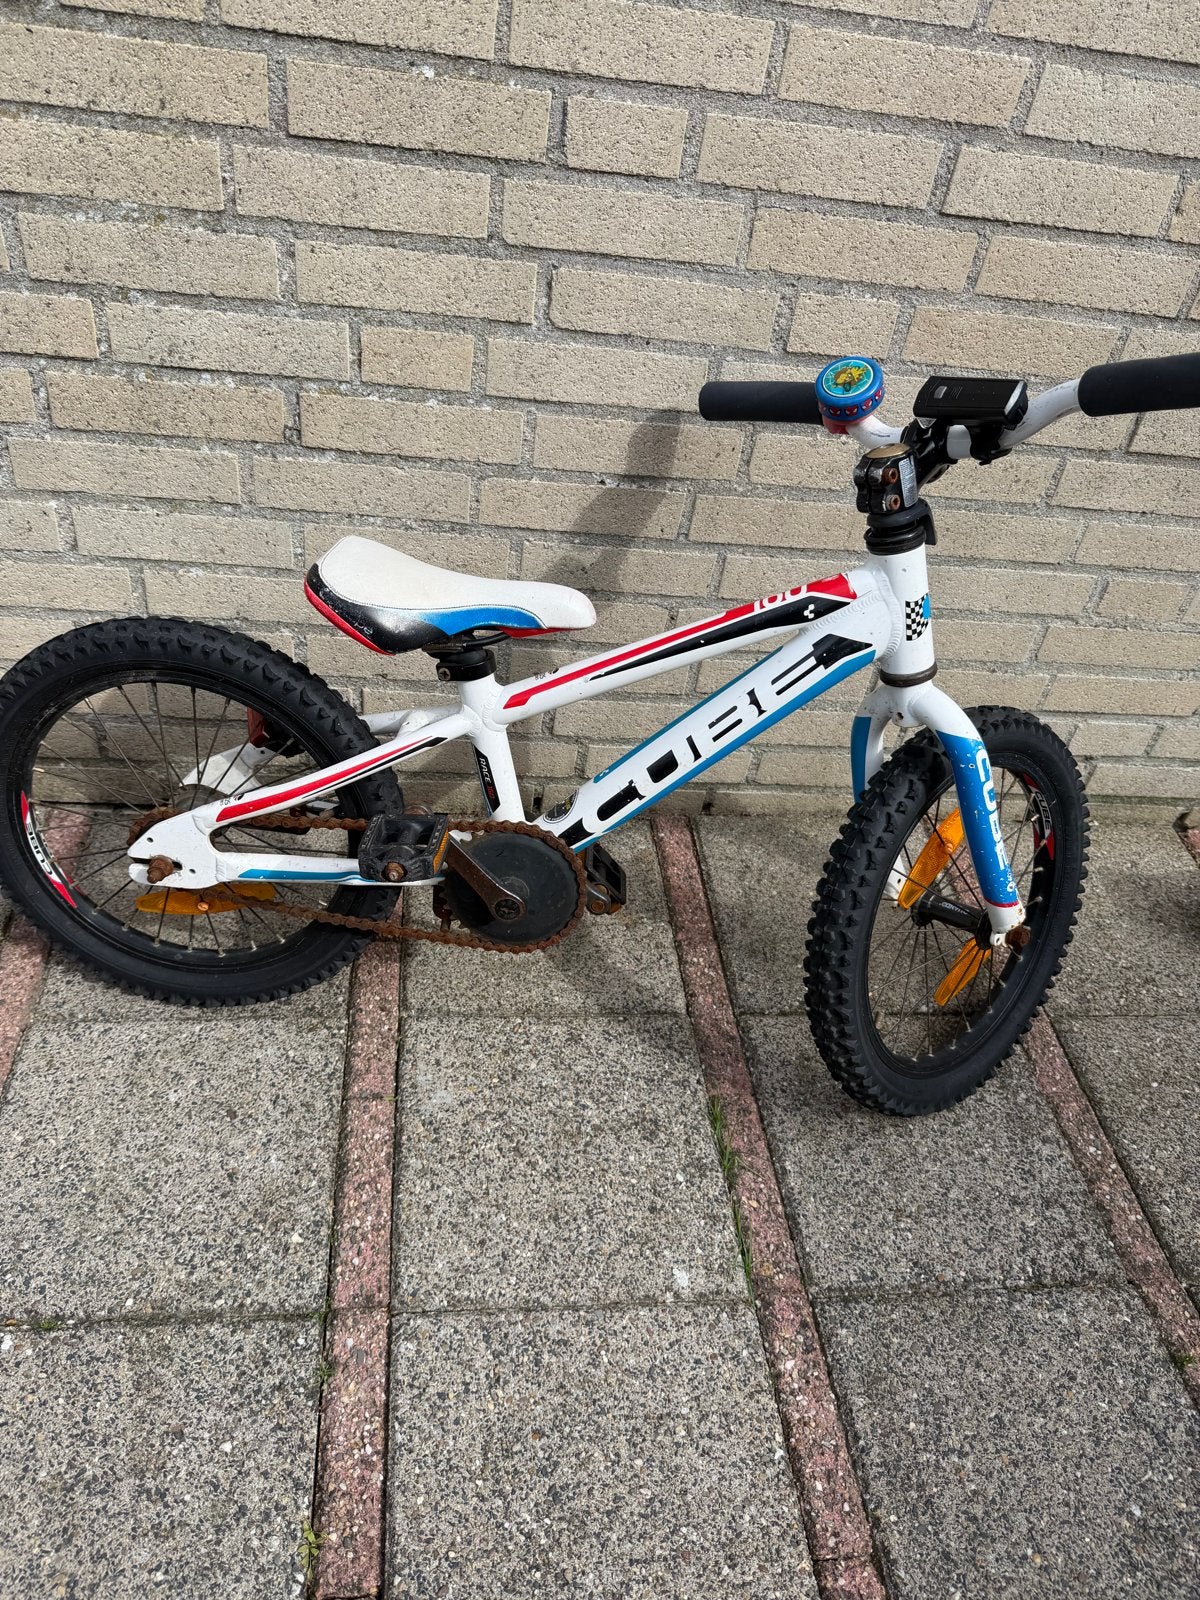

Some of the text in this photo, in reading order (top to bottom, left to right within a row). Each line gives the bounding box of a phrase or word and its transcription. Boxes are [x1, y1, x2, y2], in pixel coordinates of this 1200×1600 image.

[580, 636, 828, 838] CUBE
[479, 757, 492, 784] RACE
[975, 747, 1008, 871] CUBE
[1035, 790, 1052, 831] CUBE
[26, 821, 53, 875] CUBE
